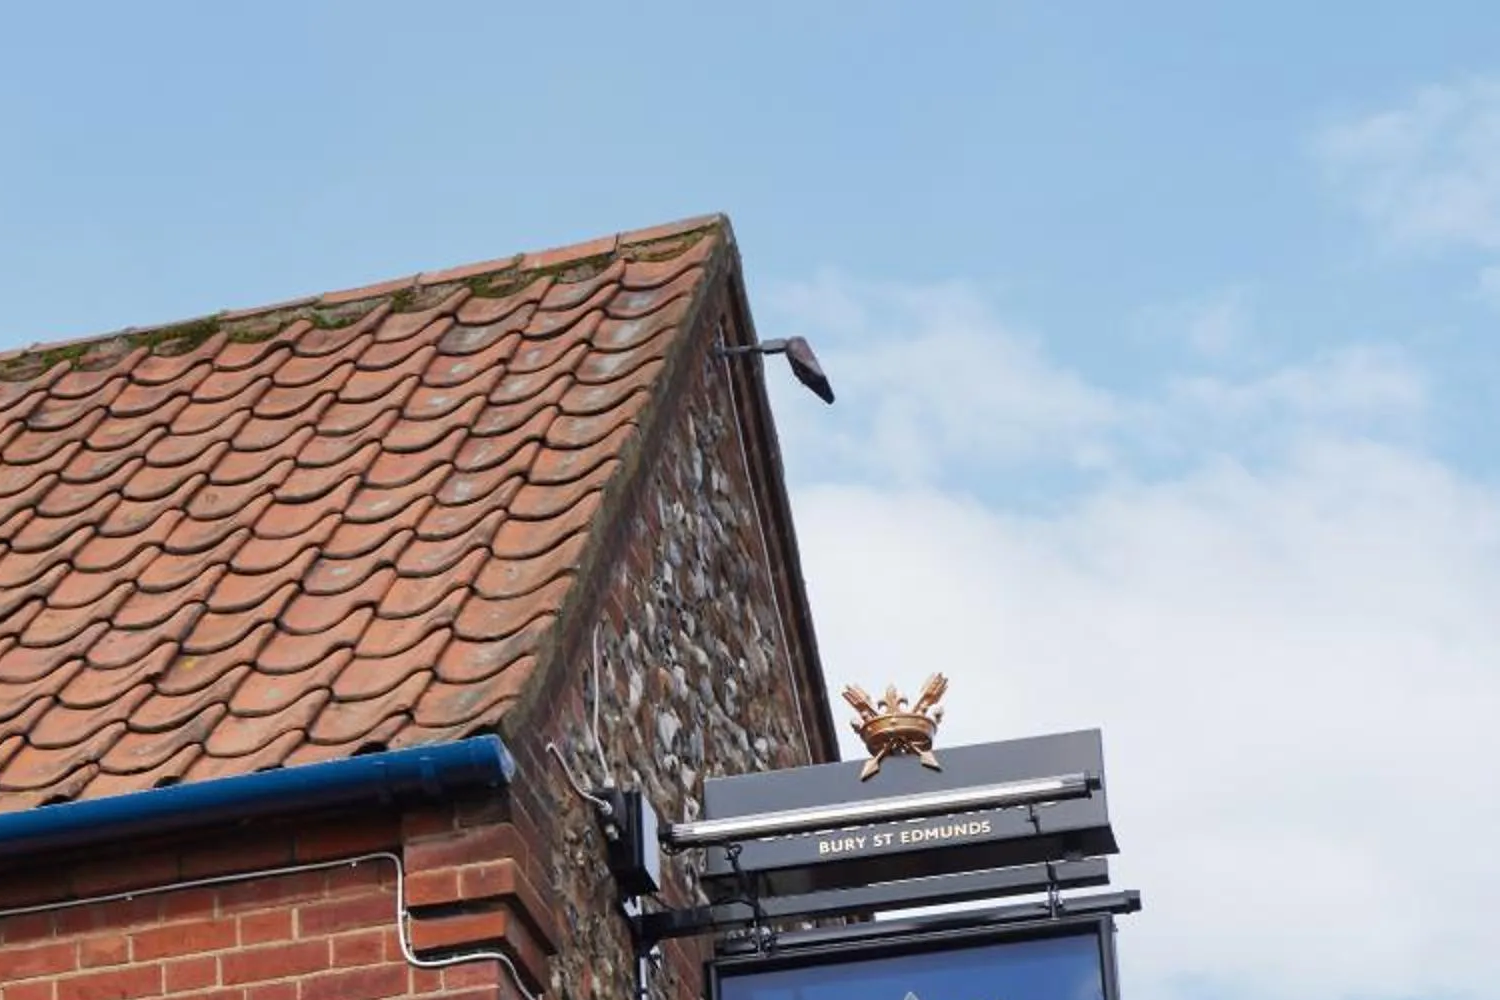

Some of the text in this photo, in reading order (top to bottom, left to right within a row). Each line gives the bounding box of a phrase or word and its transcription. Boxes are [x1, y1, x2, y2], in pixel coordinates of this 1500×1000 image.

[819, 837, 865, 854] BURY
[873, 832, 893, 847] ST
[900, 820, 992, 844] EDMUNDS
